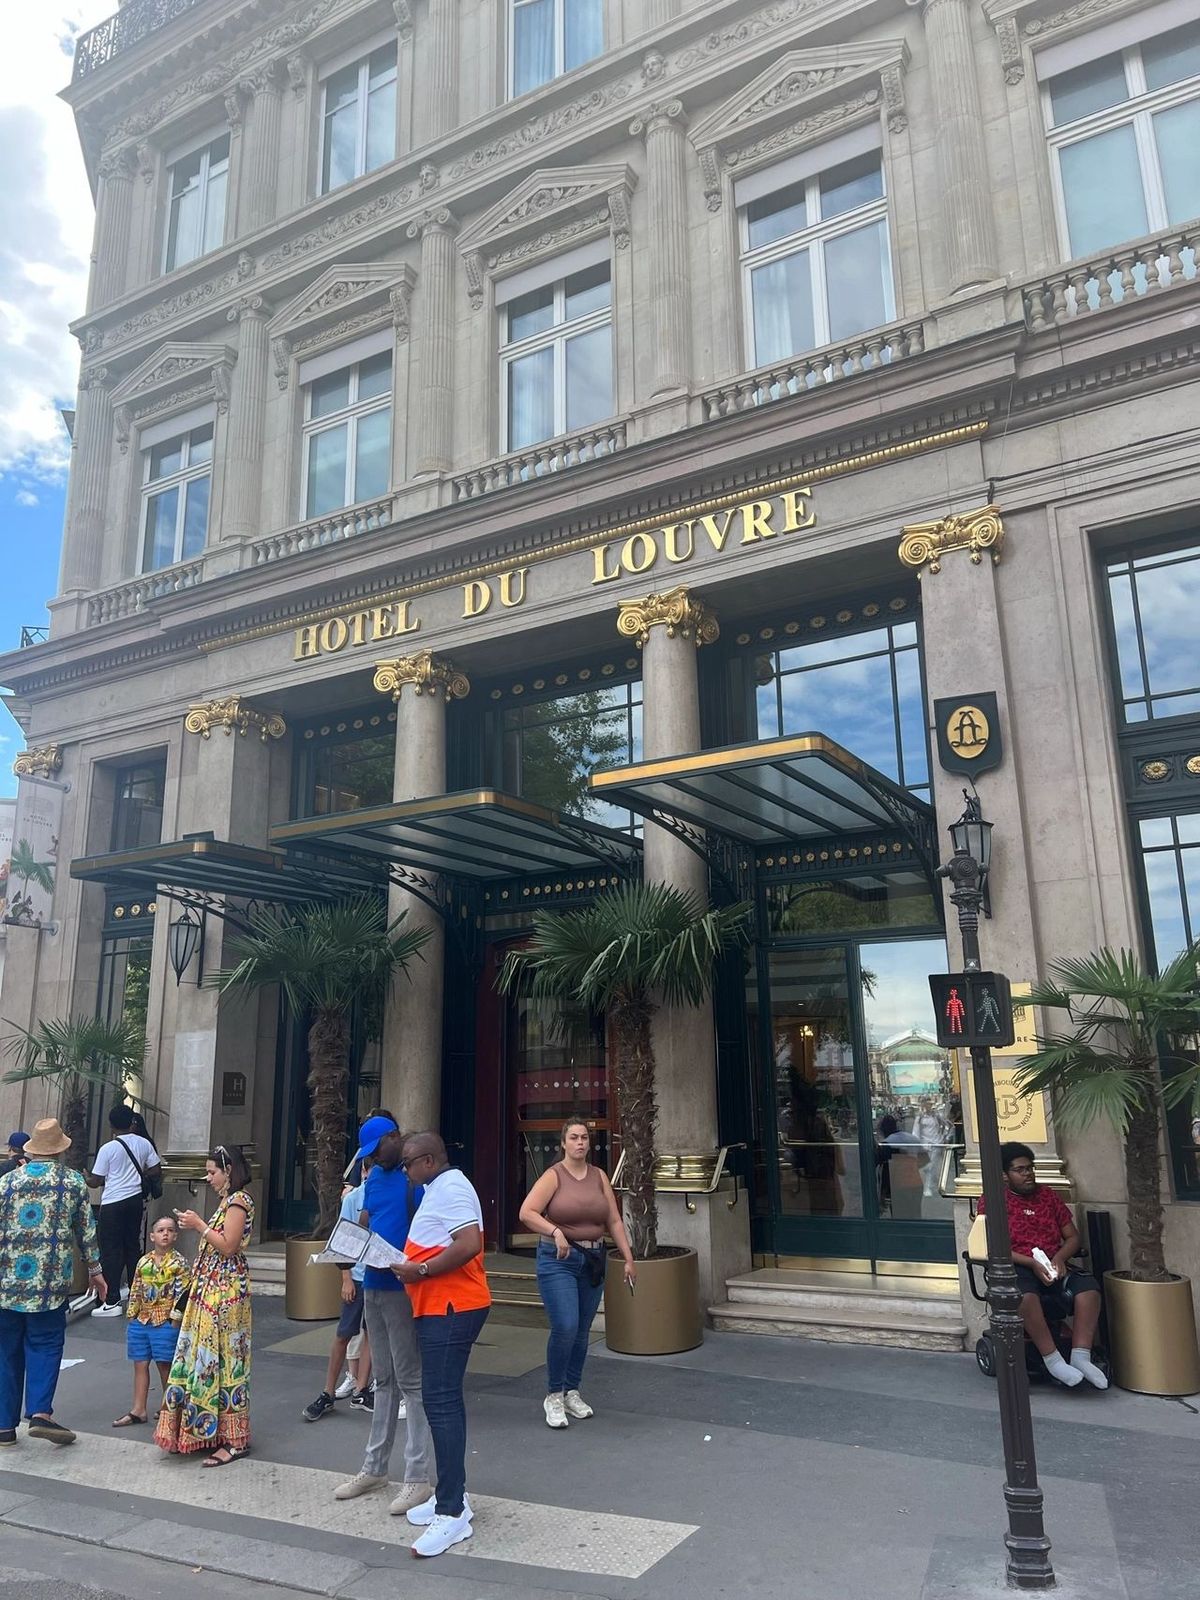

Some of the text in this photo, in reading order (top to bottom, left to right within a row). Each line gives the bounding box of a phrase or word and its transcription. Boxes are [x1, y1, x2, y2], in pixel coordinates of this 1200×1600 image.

[293, 487, 817, 661] HOTEL DU LOUVRE
